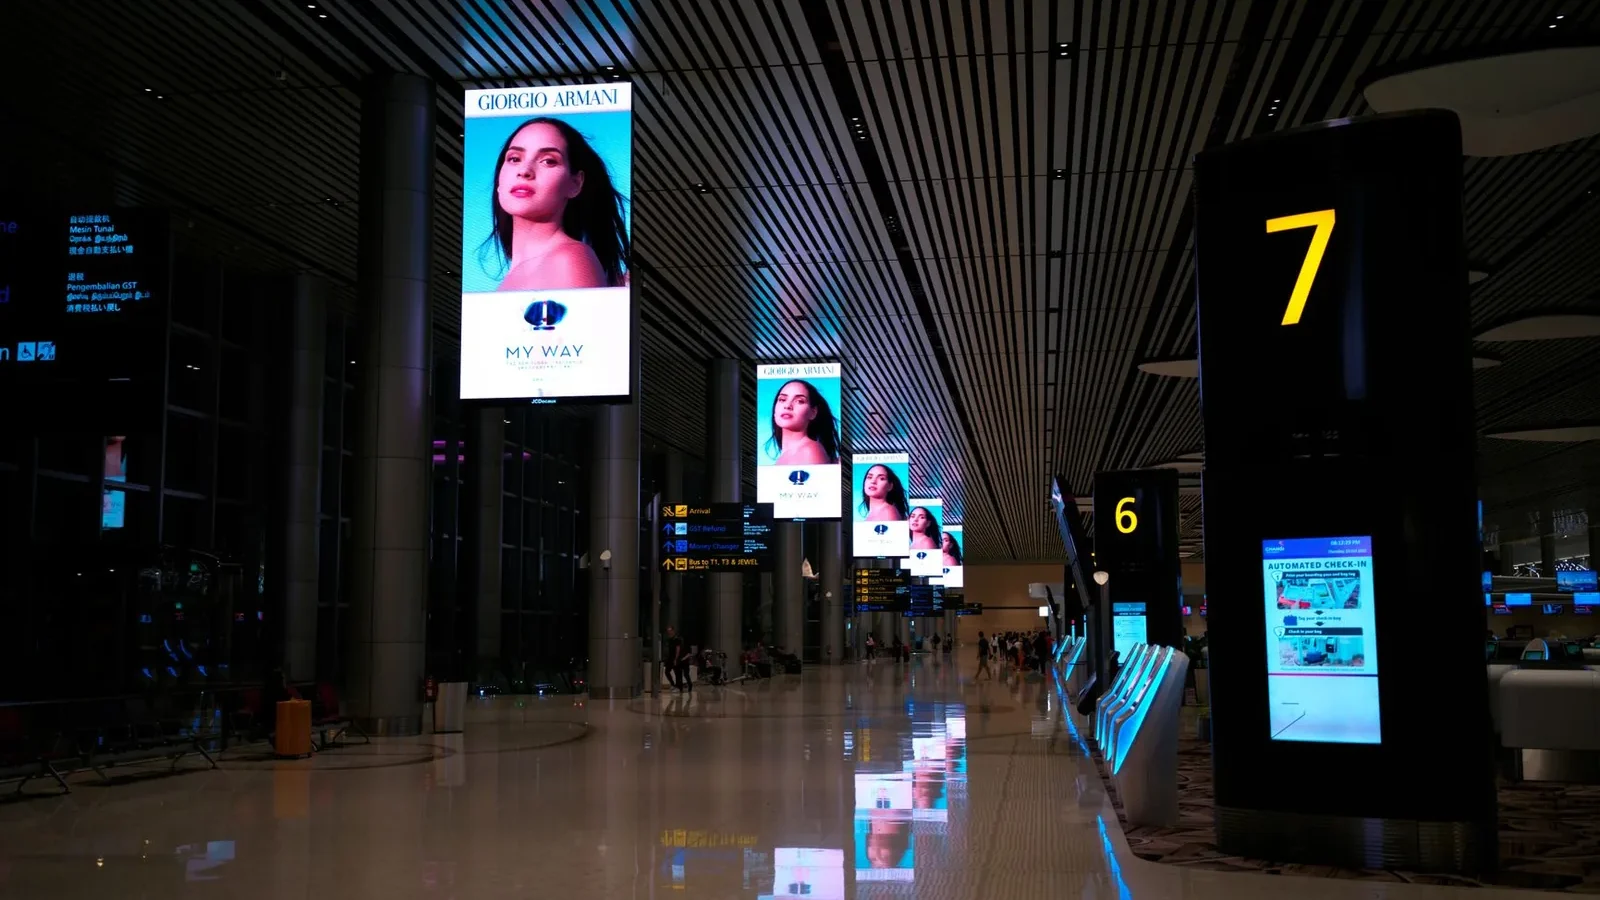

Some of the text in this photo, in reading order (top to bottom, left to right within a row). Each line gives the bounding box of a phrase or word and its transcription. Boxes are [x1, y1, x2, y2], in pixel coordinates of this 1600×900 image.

[478, 89, 618, 111] GIORGIO ARMANI
[93, 225, 115, 233] Tunai
[1266, 209, 1336, 326] 7
[67, 282, 138, 292] Pengembalian GST
[506, 345, 584, 359] MY WAY
[1115, 497, 1138, 534] 6
[712, 542, 740, 551] Changer
[688, 558, 701, 566] Bus
[731, 558, 736, 566] &
[737, 558, 759, 566] JEWEL
[1268, 560, 1367, 570] AUTOMATED CHECK-IN
